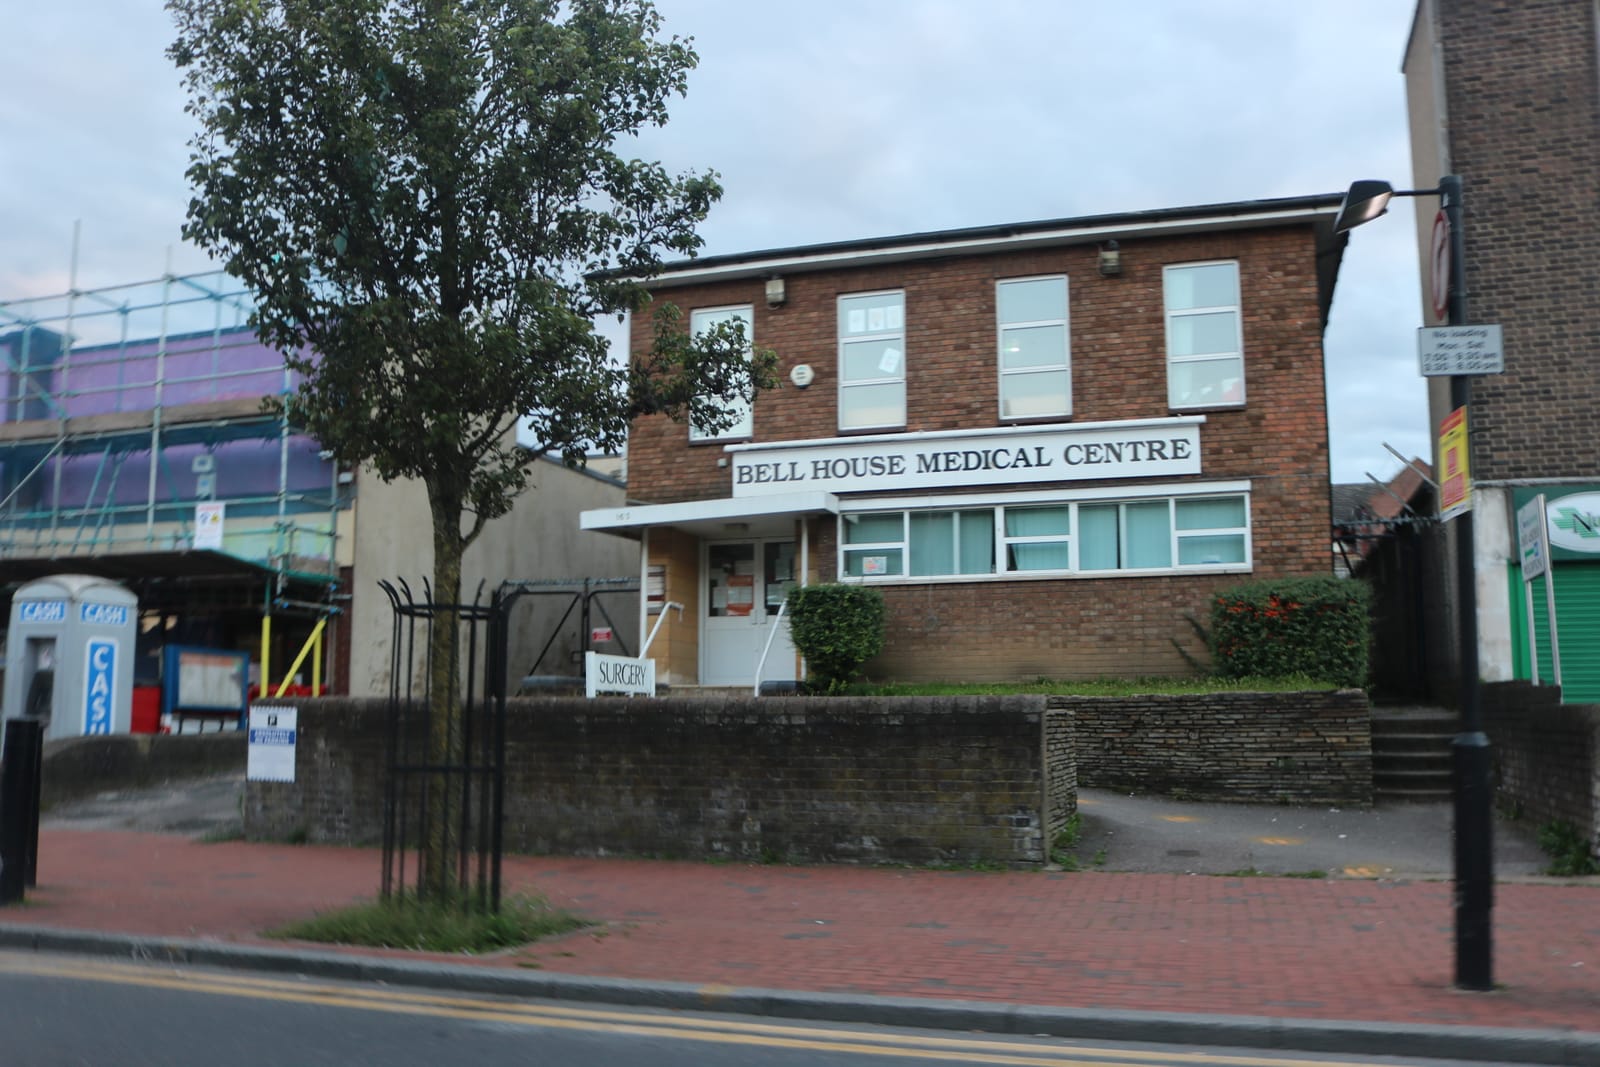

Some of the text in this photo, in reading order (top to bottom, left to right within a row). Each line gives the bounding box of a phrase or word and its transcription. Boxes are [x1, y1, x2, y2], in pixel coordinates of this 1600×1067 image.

[1433, 329, 1488, 338] No loading
[736, 438, 1192, 485] BELL HOUSE MEDICAL CENTRE
[23, 602, 61, 620] CASH
[83, 604, 123, 624] CASH
[599, 661, 647, 686] SURGERY
